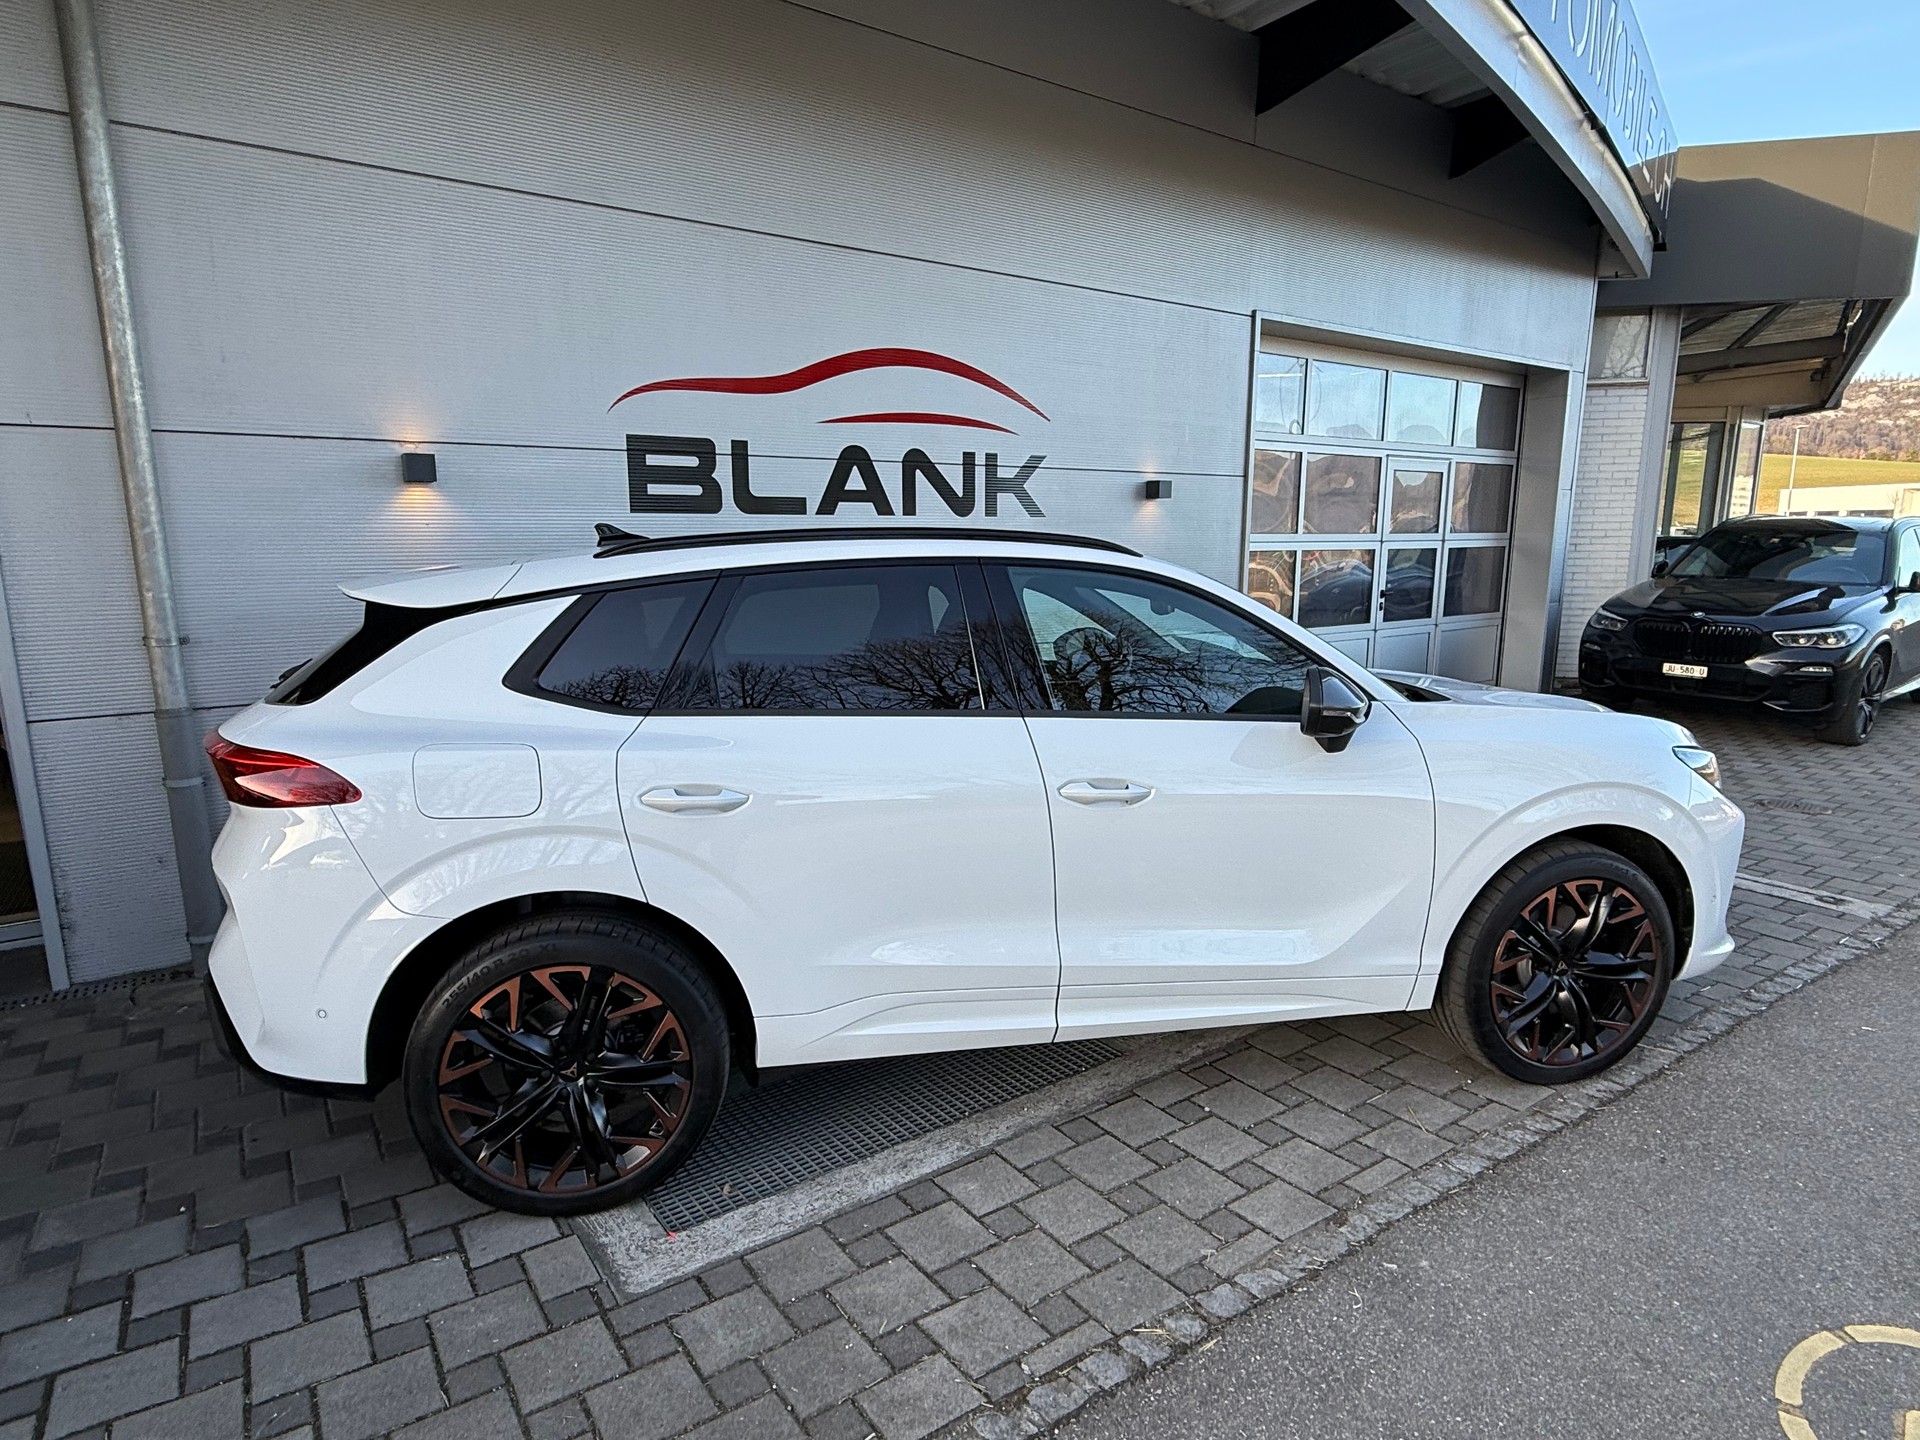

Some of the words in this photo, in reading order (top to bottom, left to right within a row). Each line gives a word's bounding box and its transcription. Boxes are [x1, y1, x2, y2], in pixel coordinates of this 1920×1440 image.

[1551, 0, 1674, 219] OMOBILE.CH
[625, 433, 1048, 518] BLANK
[1680, 666, 1695, 674] 580
[441, 965, 490, 1009] 255/40
